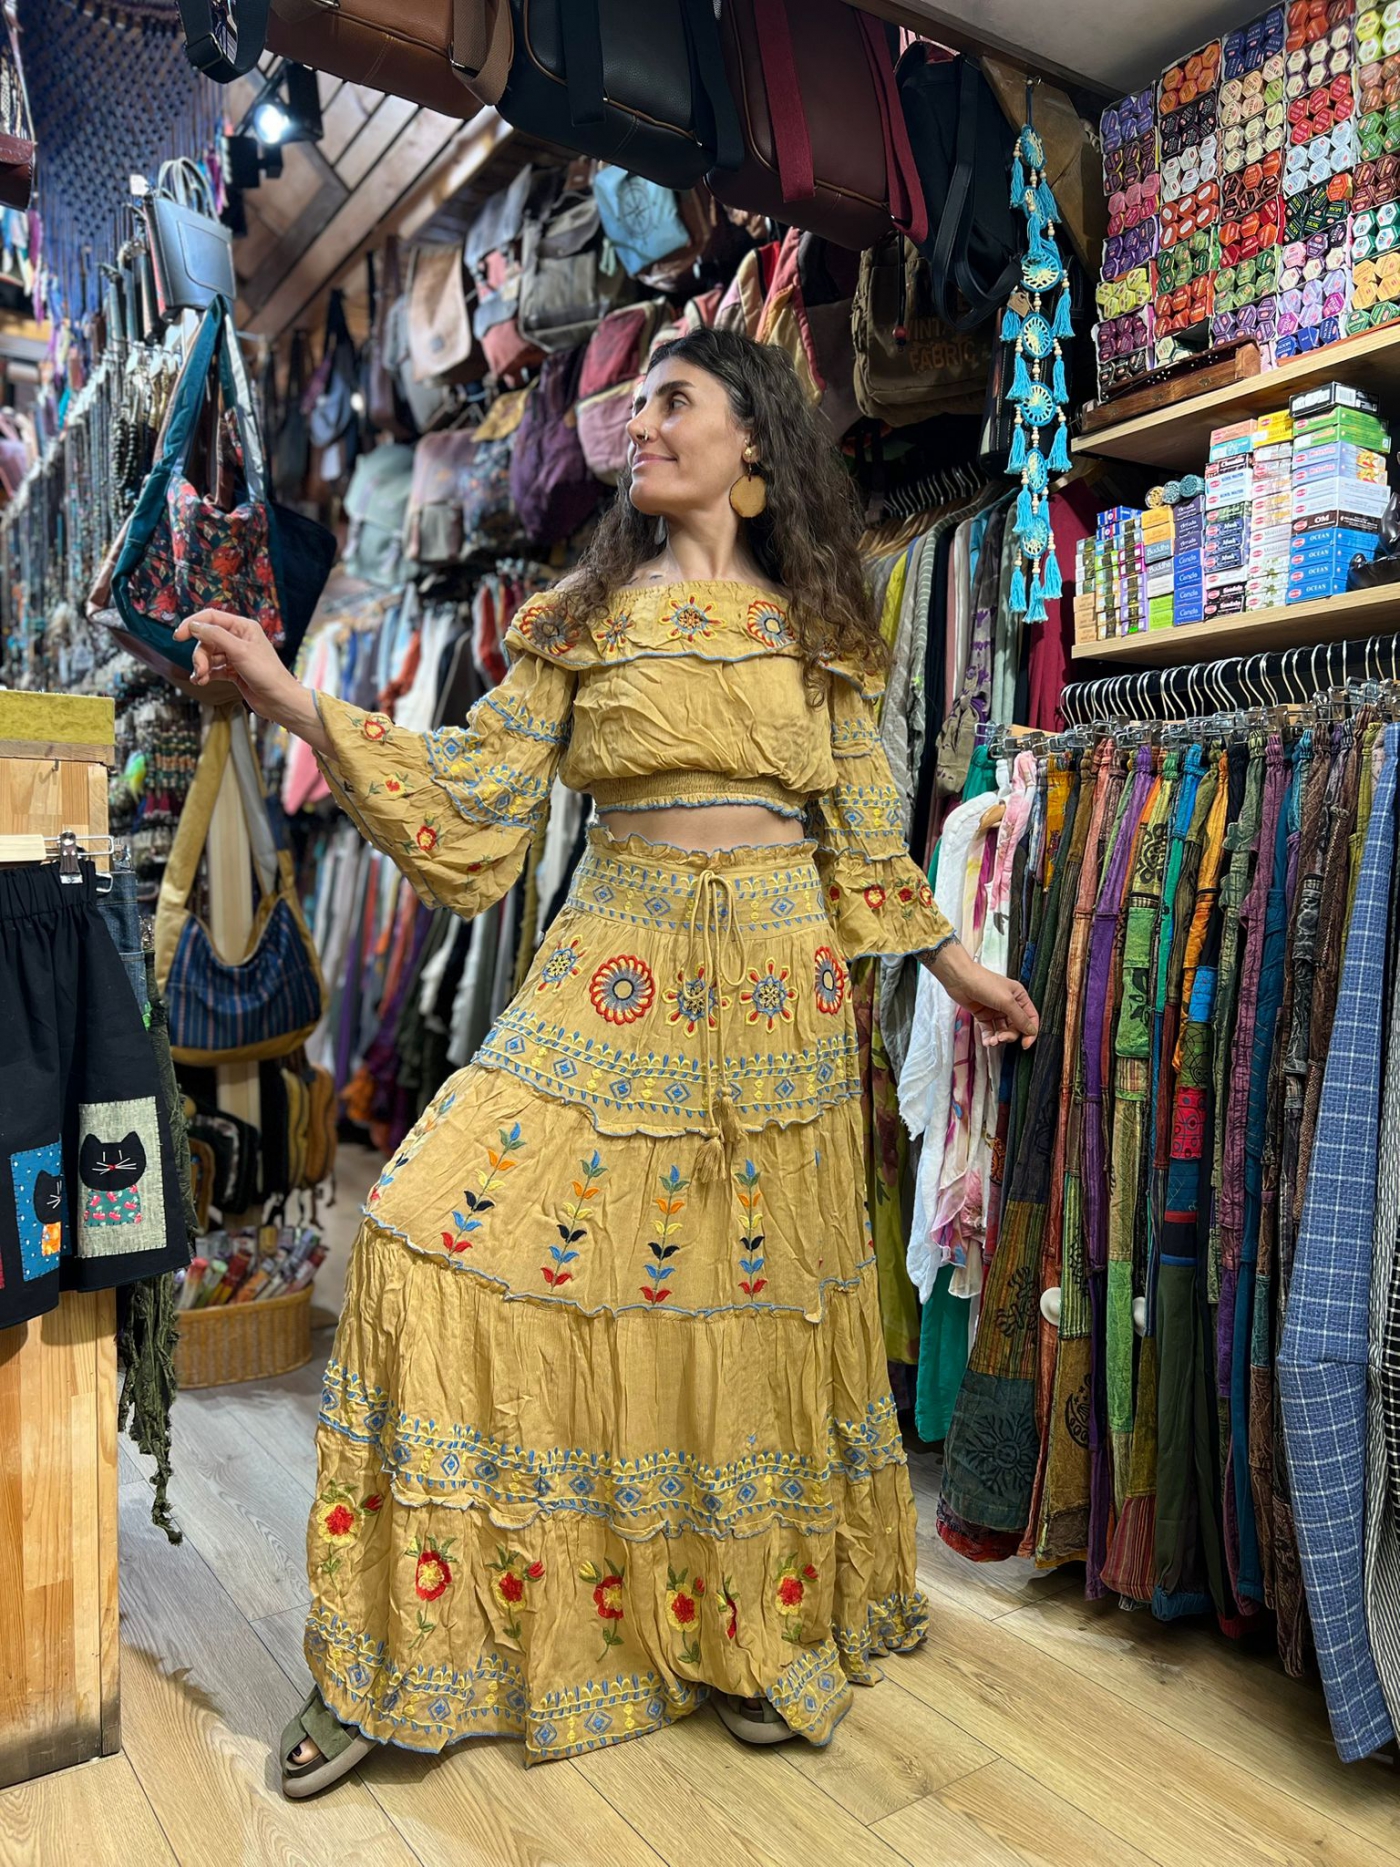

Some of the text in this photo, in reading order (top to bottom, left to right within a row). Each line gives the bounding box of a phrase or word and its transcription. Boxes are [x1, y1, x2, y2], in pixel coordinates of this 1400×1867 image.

[909, 341, 977, 372] FABRIC
[1314, 514, 1330, 524] OM
[1309, 532, 1330, 541] OCEAN
[1308, 549, 1329, 558] OCEAN
[1308, 566, 1329, 575] OCEAN
[1306, 583, 1327, 593] OCEAN
